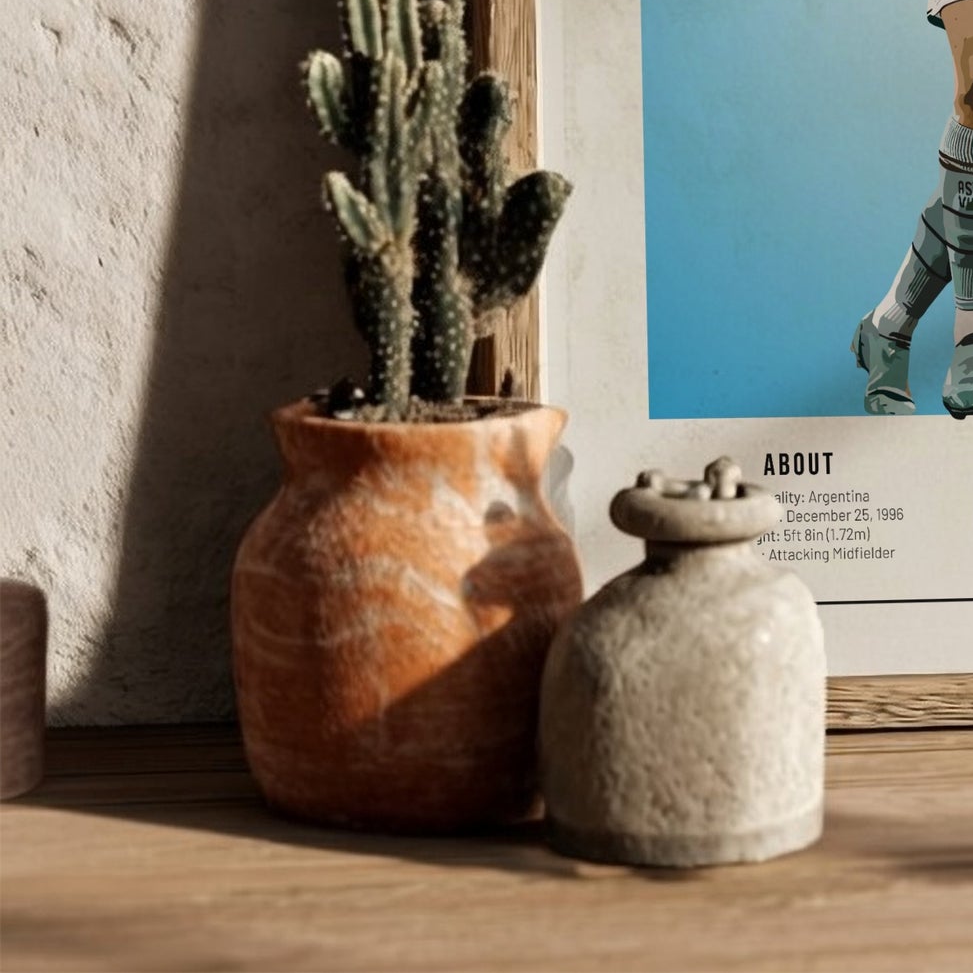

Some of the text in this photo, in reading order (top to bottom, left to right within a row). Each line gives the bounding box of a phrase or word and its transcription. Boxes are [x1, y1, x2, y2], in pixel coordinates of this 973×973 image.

[763, 452, 834, 476] ABOUT
[774, 490, 870, 507] ality: Argentina
[786, 507, 904, 523] December 25, 1996
[783, 529, 802, 542] 5ft
[769, 547, 896, 564] Attacking Midfielder
